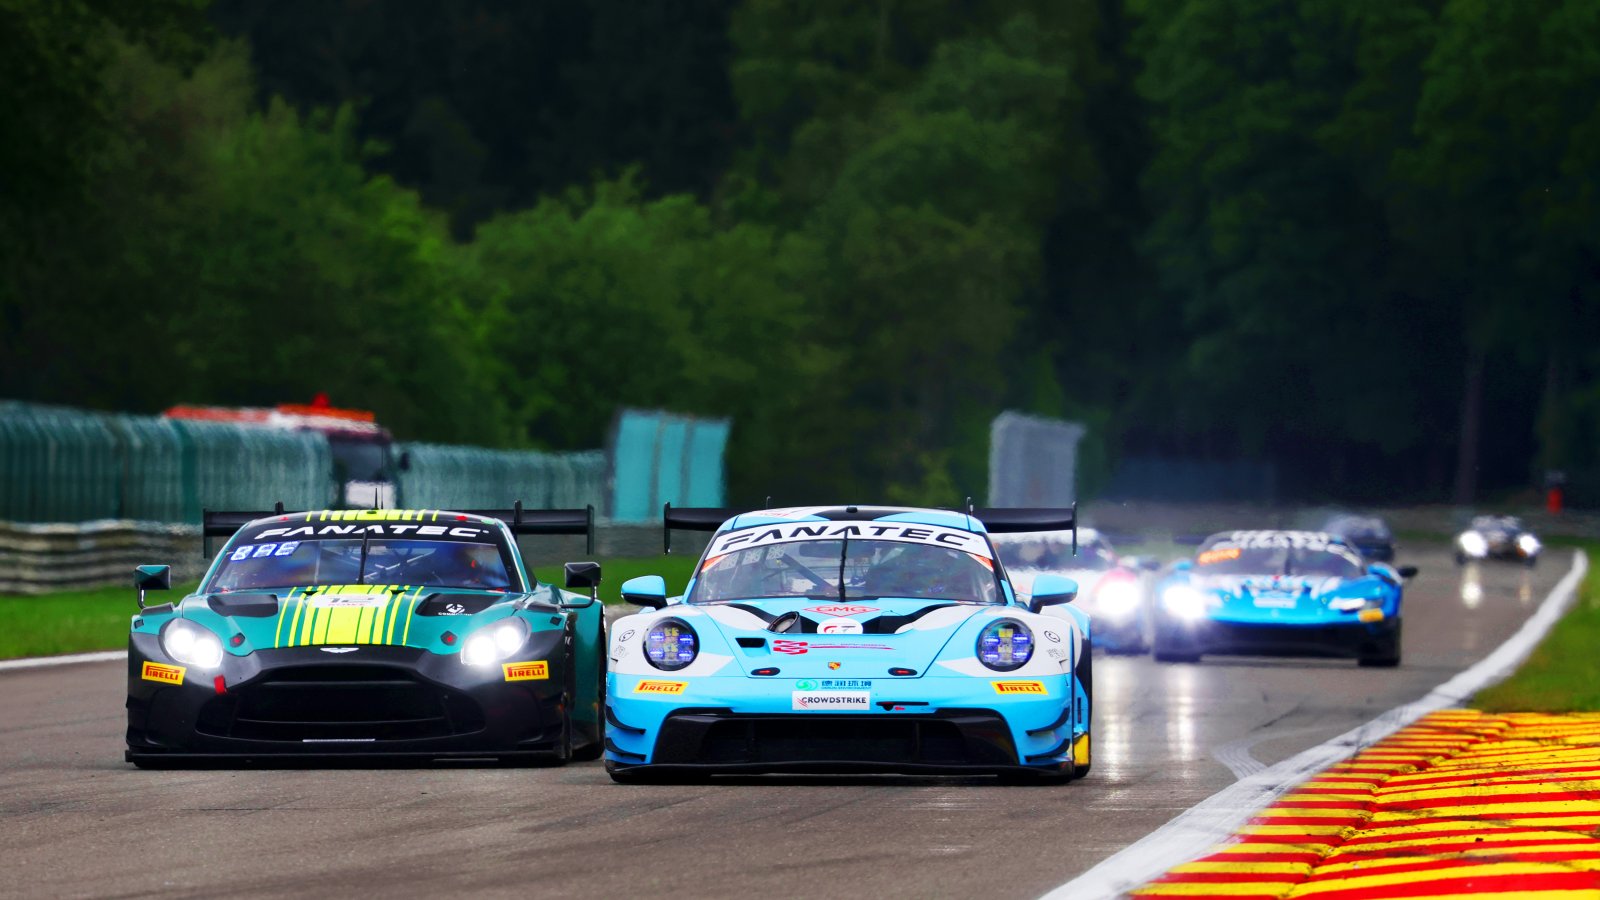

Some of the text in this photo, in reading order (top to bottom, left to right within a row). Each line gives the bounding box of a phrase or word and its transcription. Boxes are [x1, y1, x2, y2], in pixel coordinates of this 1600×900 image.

[255, 524, 483, 540] FANATEC
[720, 525, 972, 551] FANATEC
[145, 665, 180, 680] PIRELLI
[507, 664, 544, 677] PIRELLI
[639, 682, 683, 692] PIRELLI
[996, 683, 1041, 692] PIRELLI
[801, 696, 867, 704] CROWDSTRIKE
